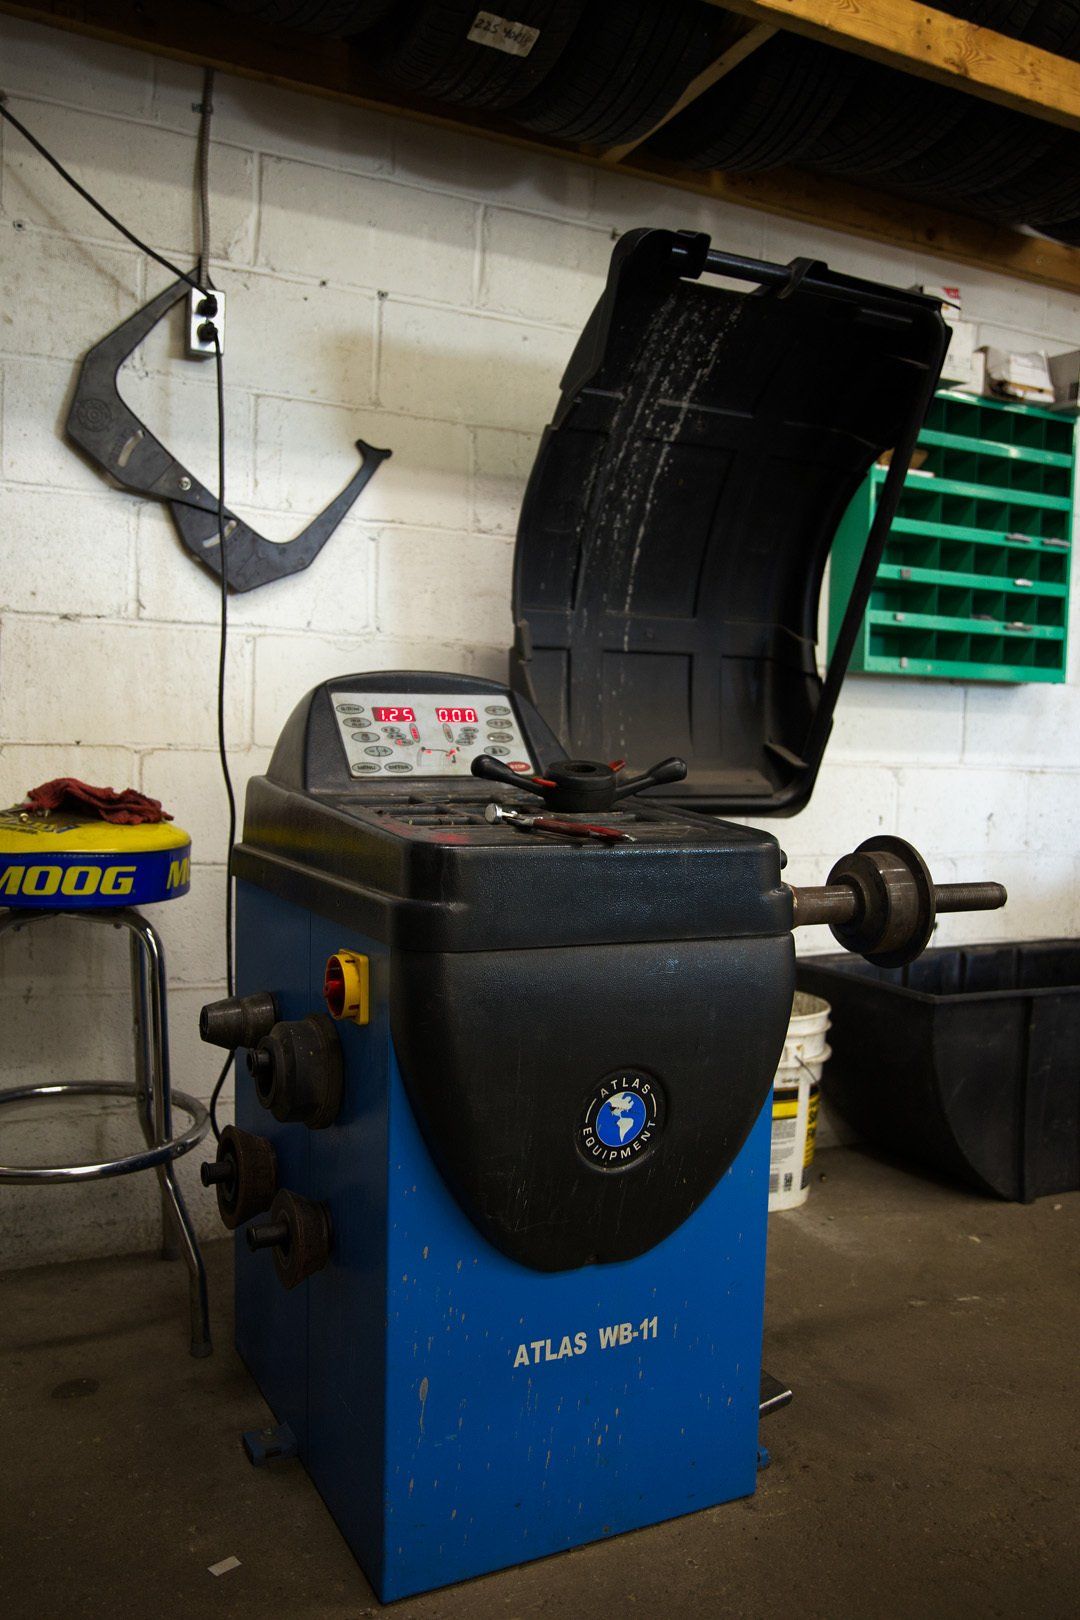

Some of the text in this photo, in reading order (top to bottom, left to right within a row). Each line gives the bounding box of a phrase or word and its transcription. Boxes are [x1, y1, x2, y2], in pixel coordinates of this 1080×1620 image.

[381, 708, 413, 721] 1.25
[438, 709, 475, 722] 0.00
[600, 1077, 651, 1098] ATLAS
[583, 1120, 656, 1160] EQUIPMENT
[513, 1315, 658, 1368] ATLAS WB-11
